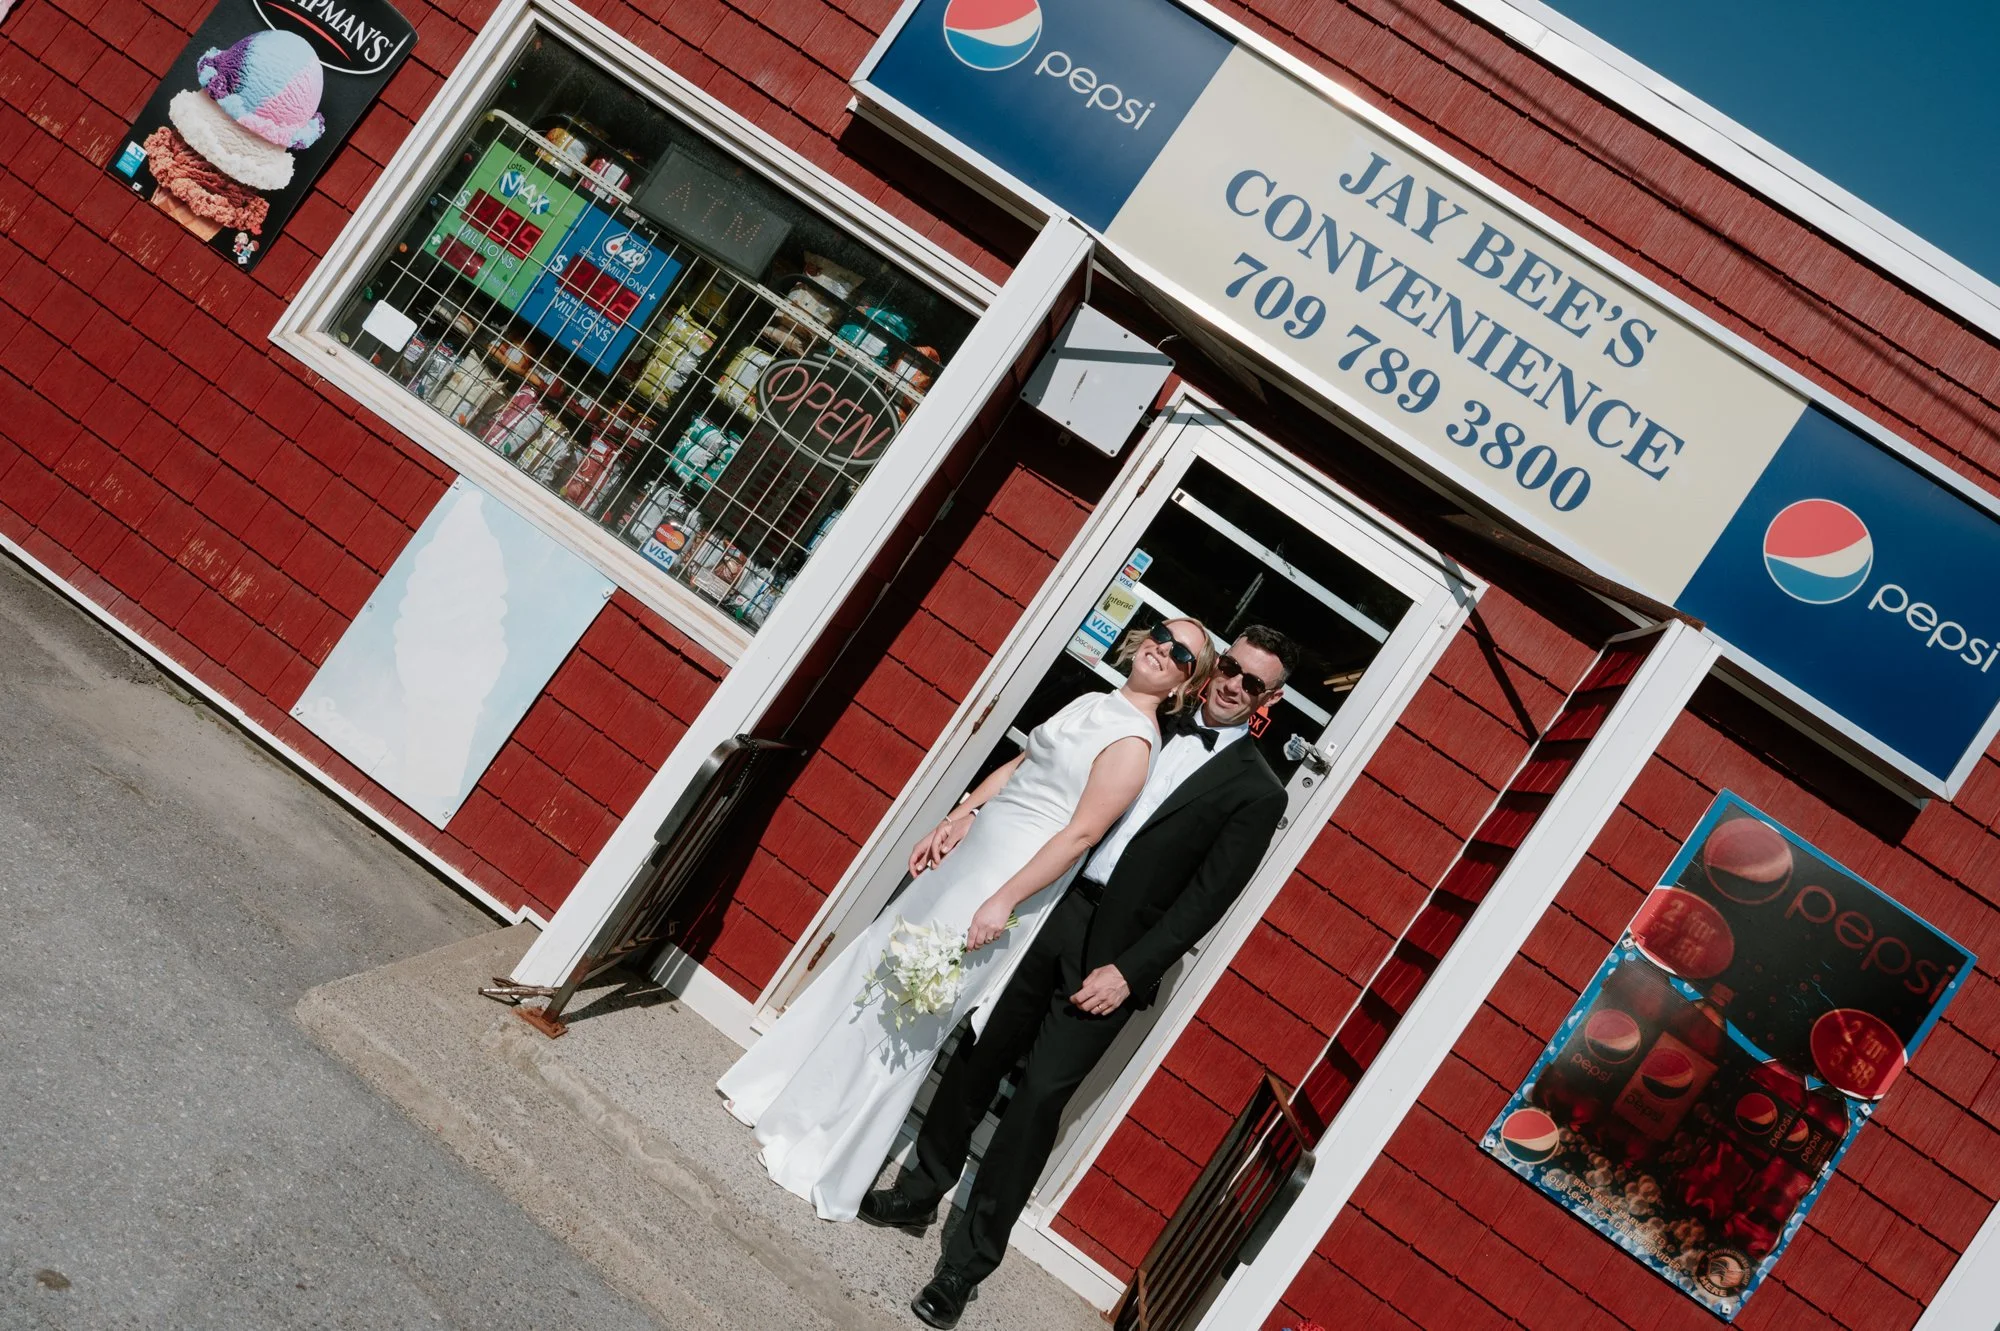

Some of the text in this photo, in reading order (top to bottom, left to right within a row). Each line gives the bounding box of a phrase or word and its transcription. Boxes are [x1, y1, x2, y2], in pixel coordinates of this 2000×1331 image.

[1034, 51, 1156, 130] pepsi
[500, 170, 550, 215] MAX
[1339, 152, 1657, 368] JAY BEE'S
[1225, 169, 1685, 481] CONVENIENCE
[1225, 252, 1592, 512] 709 789 3800
[768, 366, 891, 457] OPEN
[649, 544, 673, 566] VISA
[1119, 576, 1134, 589] VISA
[1106, 593, 1134, 610] Interac
[1091, 615, 1118, 641] VISA
[1867, 584, 2000, 673] pepsi
[1074, 636, 1102, 657] DISCOVER
[1663, 900, 1684, 922] 2
[1784, 885, 1956, 1005] pepsi
[1570, 1053, 1614, 1083] pepsi
[1769, 1113, 1793, 1148] pepsi
[1800, 1130, 1823, 1163] pepsi
[1545, 1172, 1568, 1191] YOUR
[1567, 1187, 1594, 1209] LOCAL
[1593, 1204, 1616, 1223] SOFT
[1614, 1219, 1642, 1243] DRINK
[1573, 1178, 1621, 1213] BROWNING
[1699, 1275, 1728, 1297] HERE
